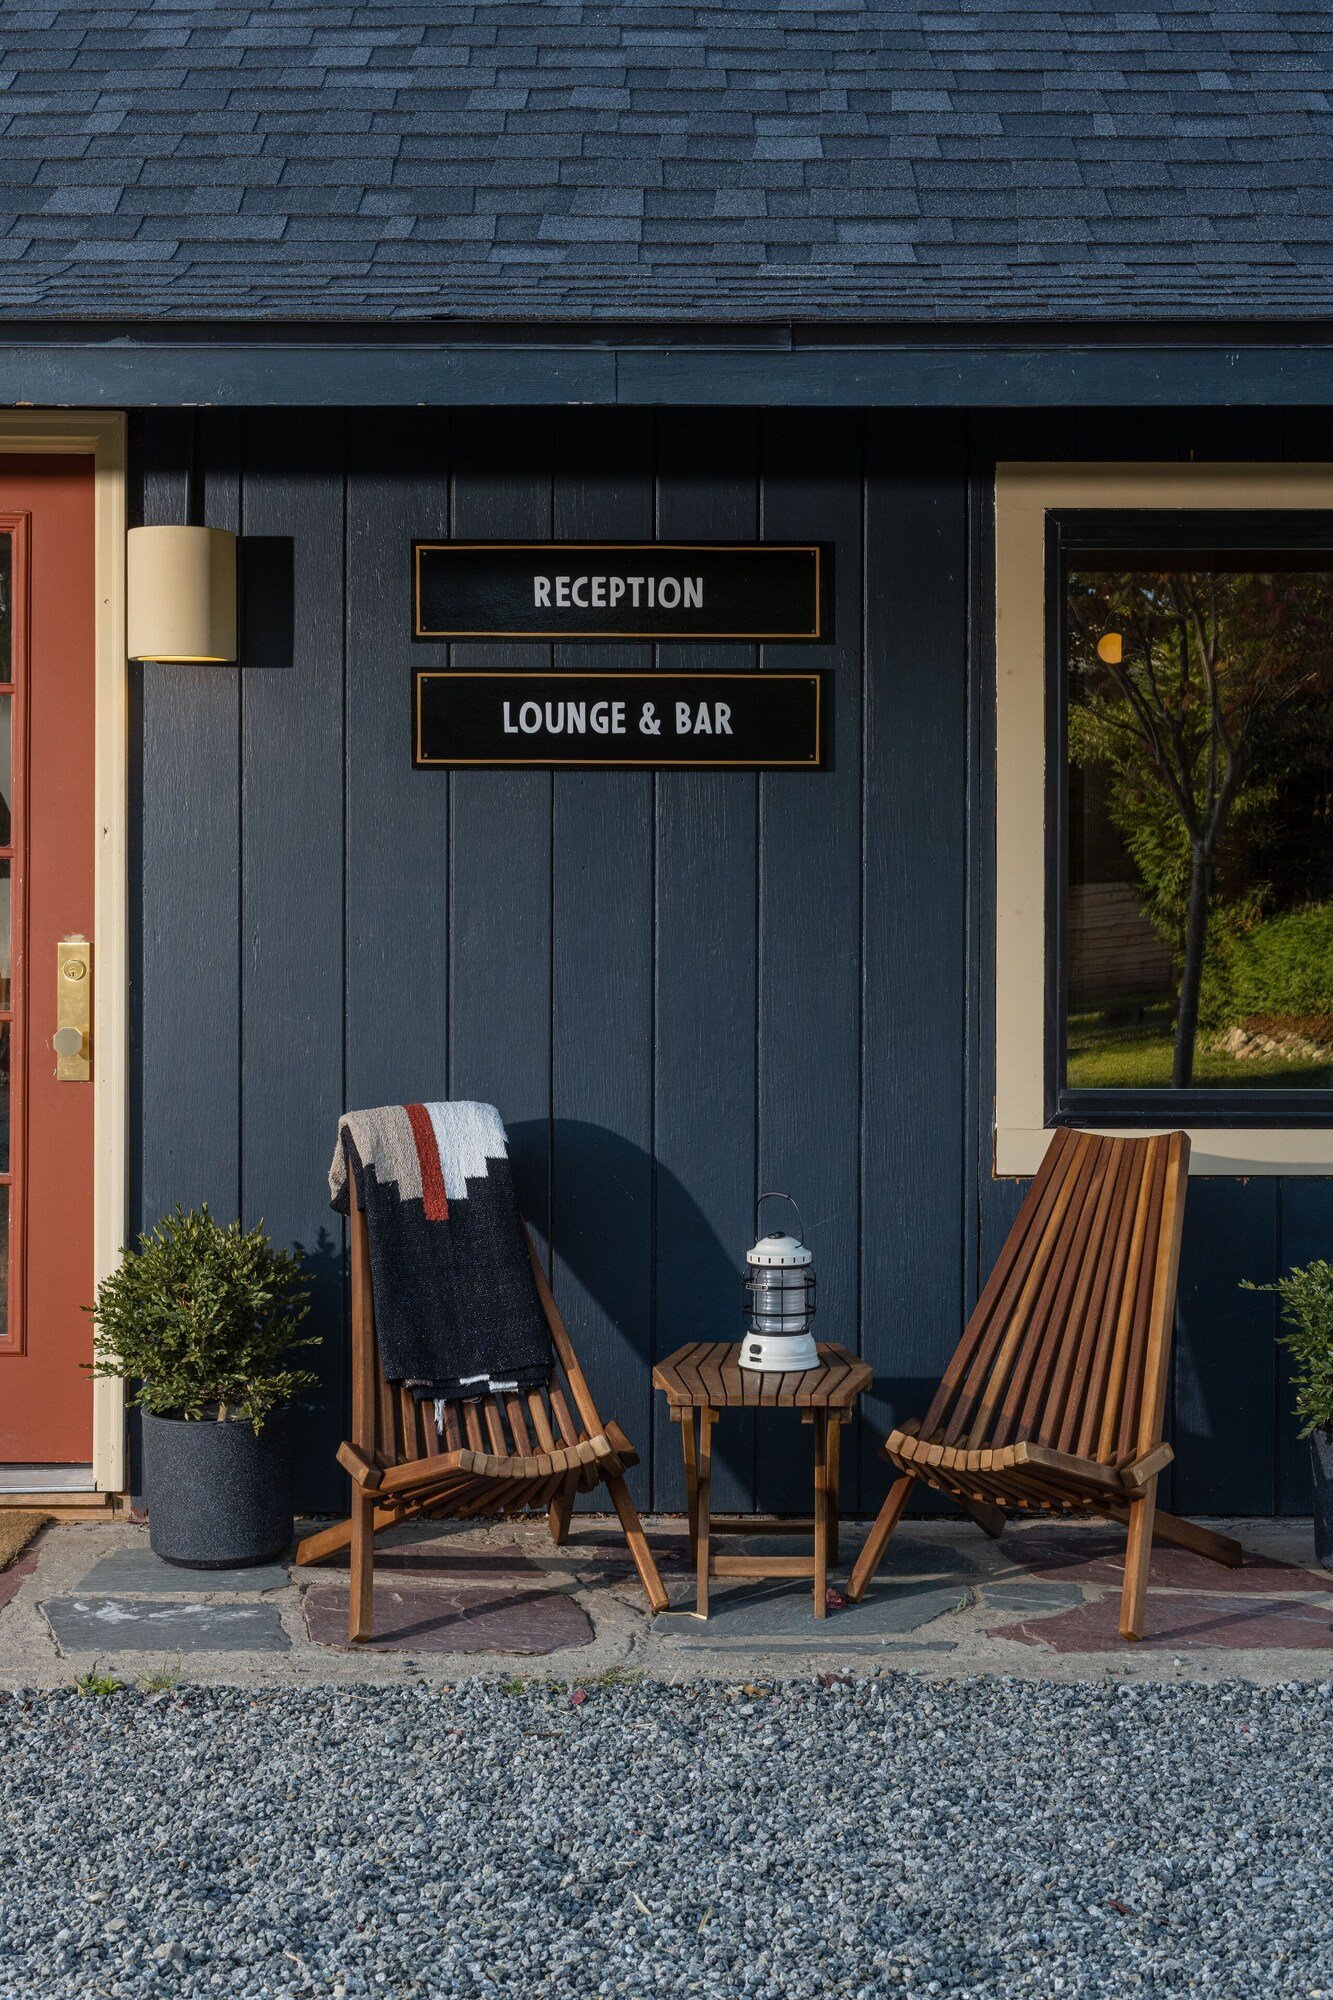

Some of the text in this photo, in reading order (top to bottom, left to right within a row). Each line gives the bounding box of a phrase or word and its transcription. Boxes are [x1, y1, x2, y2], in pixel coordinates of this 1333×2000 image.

[533, 575, 704, 608] RECEPTION
[502, 701, 734, 735] LOUNGE & BAR
